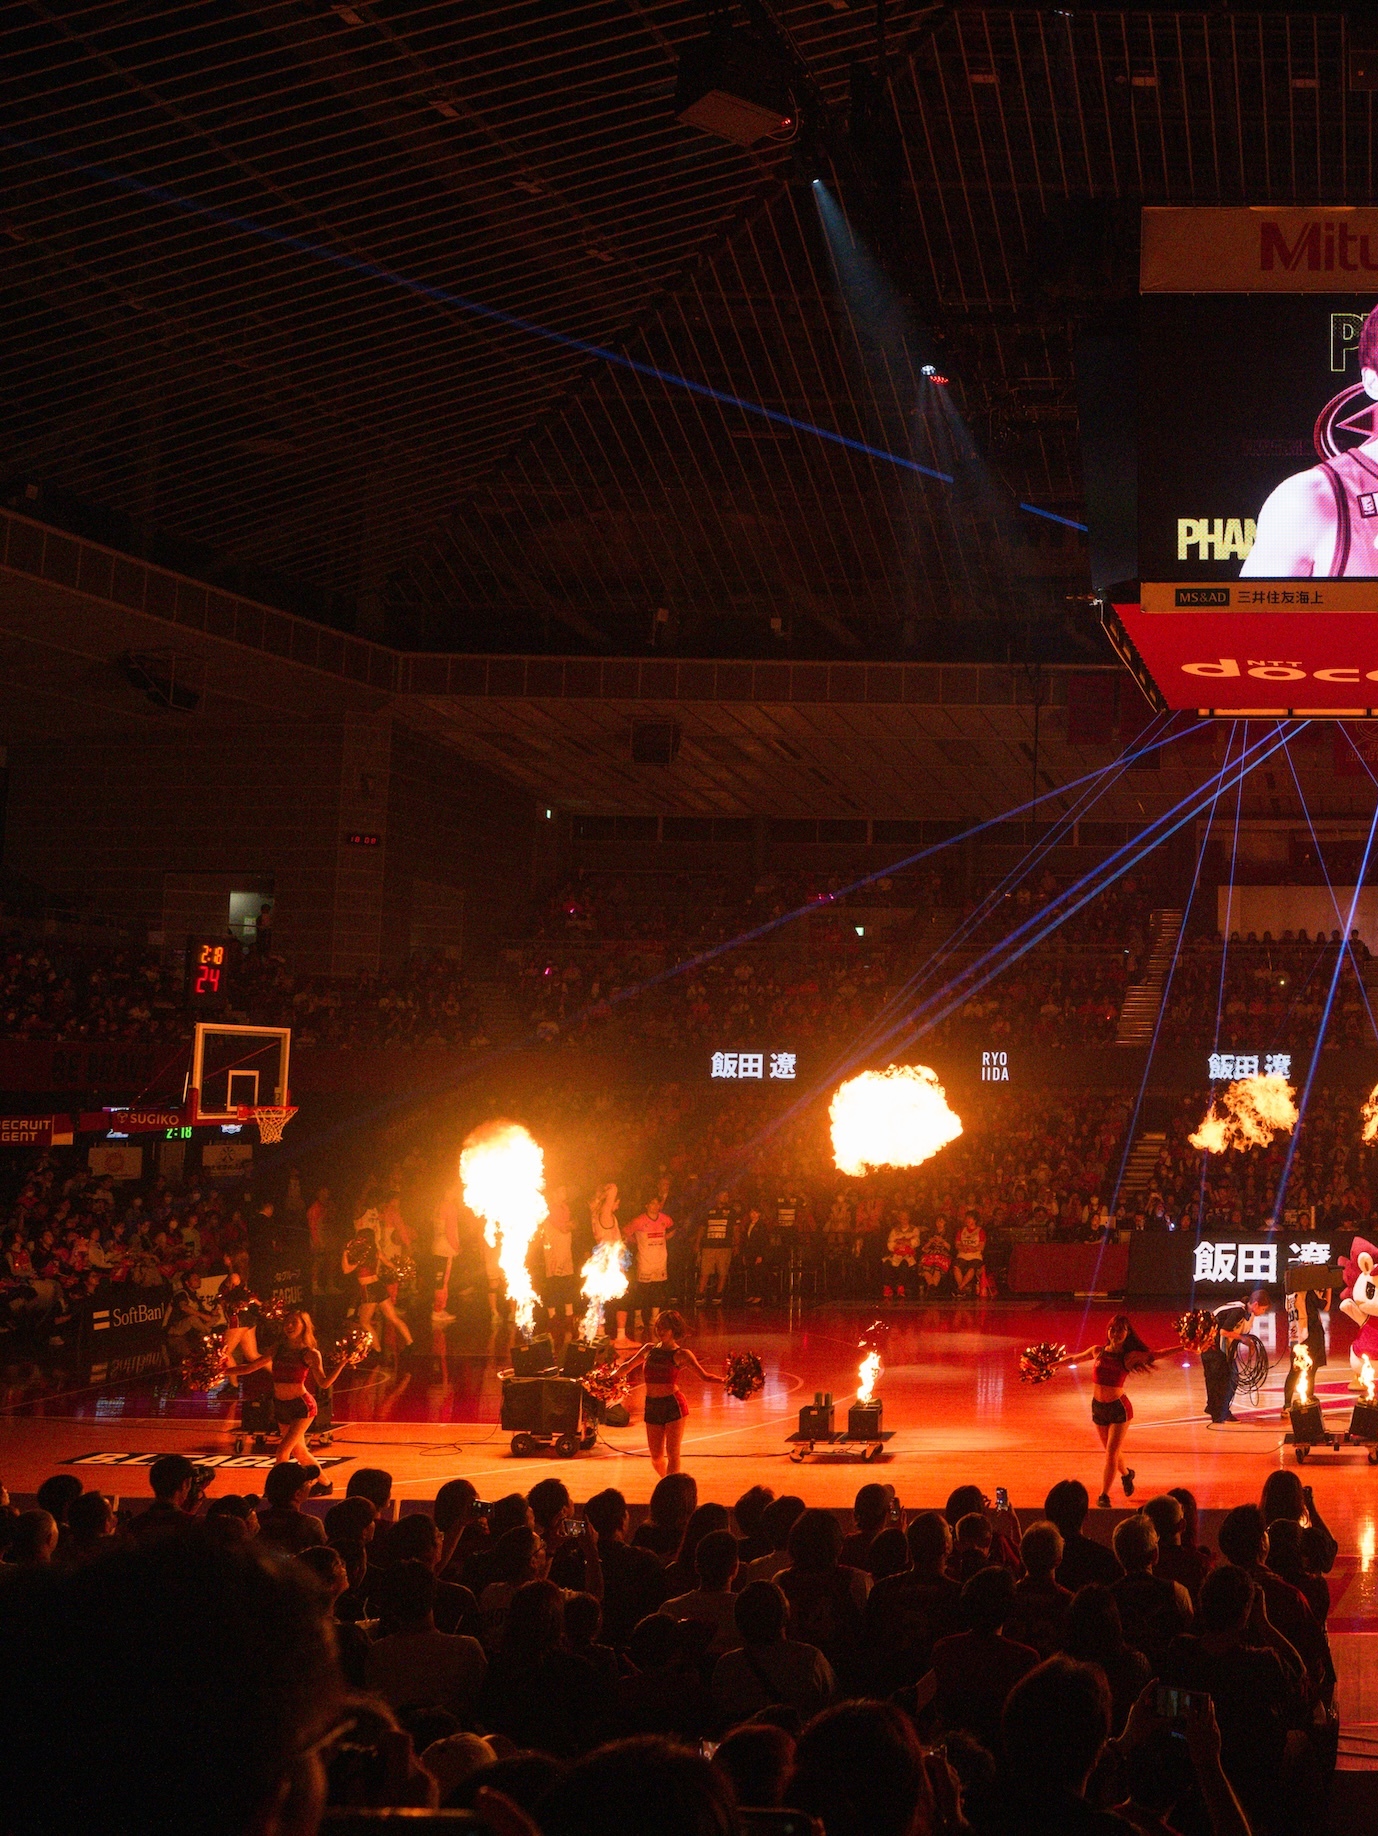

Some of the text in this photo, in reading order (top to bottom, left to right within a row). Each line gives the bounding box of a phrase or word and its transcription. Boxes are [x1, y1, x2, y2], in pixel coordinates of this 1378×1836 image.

[1179, 591, 1324, 604] MS&AD 三井住友海上
[1246, 660, 1303, 668] NTT
[196, 965, 221, 993] 24
[981, 1051, 1008, 1065] RYO
[710, 1051, 798, 1080] 飯田 遼
[1207, 1053, 1259, 1080] 飯田
[981, 1067, 1009, 1081] IIDA
[0, 1120, 51, 1130] ECRUIT
[130, 1113, 179, 1125] SUGIKO
[166, 1126, 193, 1139] 2:18
[1193, 1241, 1278, 1283] 飯田
[73, 1452, 342, 1468] B.LAGU
